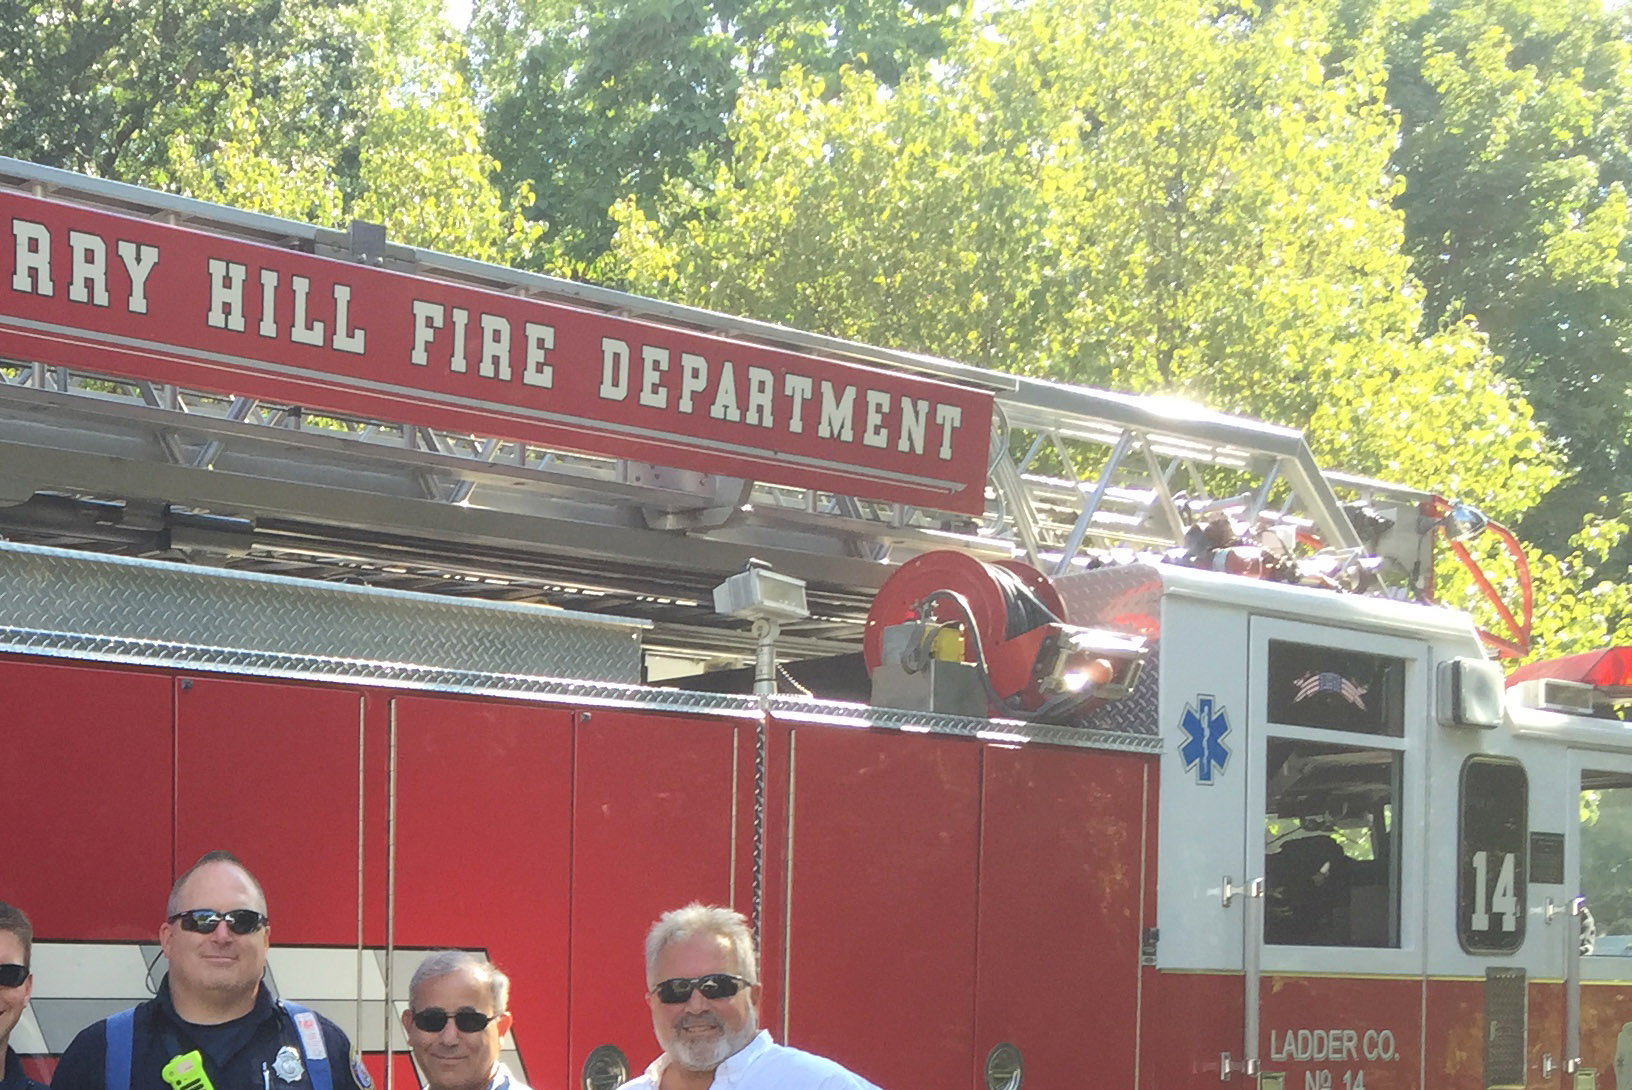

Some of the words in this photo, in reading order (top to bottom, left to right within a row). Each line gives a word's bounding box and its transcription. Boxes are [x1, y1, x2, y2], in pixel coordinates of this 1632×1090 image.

[207, 258, 366, 355] HILL
[410, 300, 555, 390] FIRE
[599, 337, 963, 461] DEPARTMENT
[1471, 851, 1518, 931] 14
[1270, 1029, 1359, 1061] LADDER
[1363, 1029, 1400, 1061] CO.
